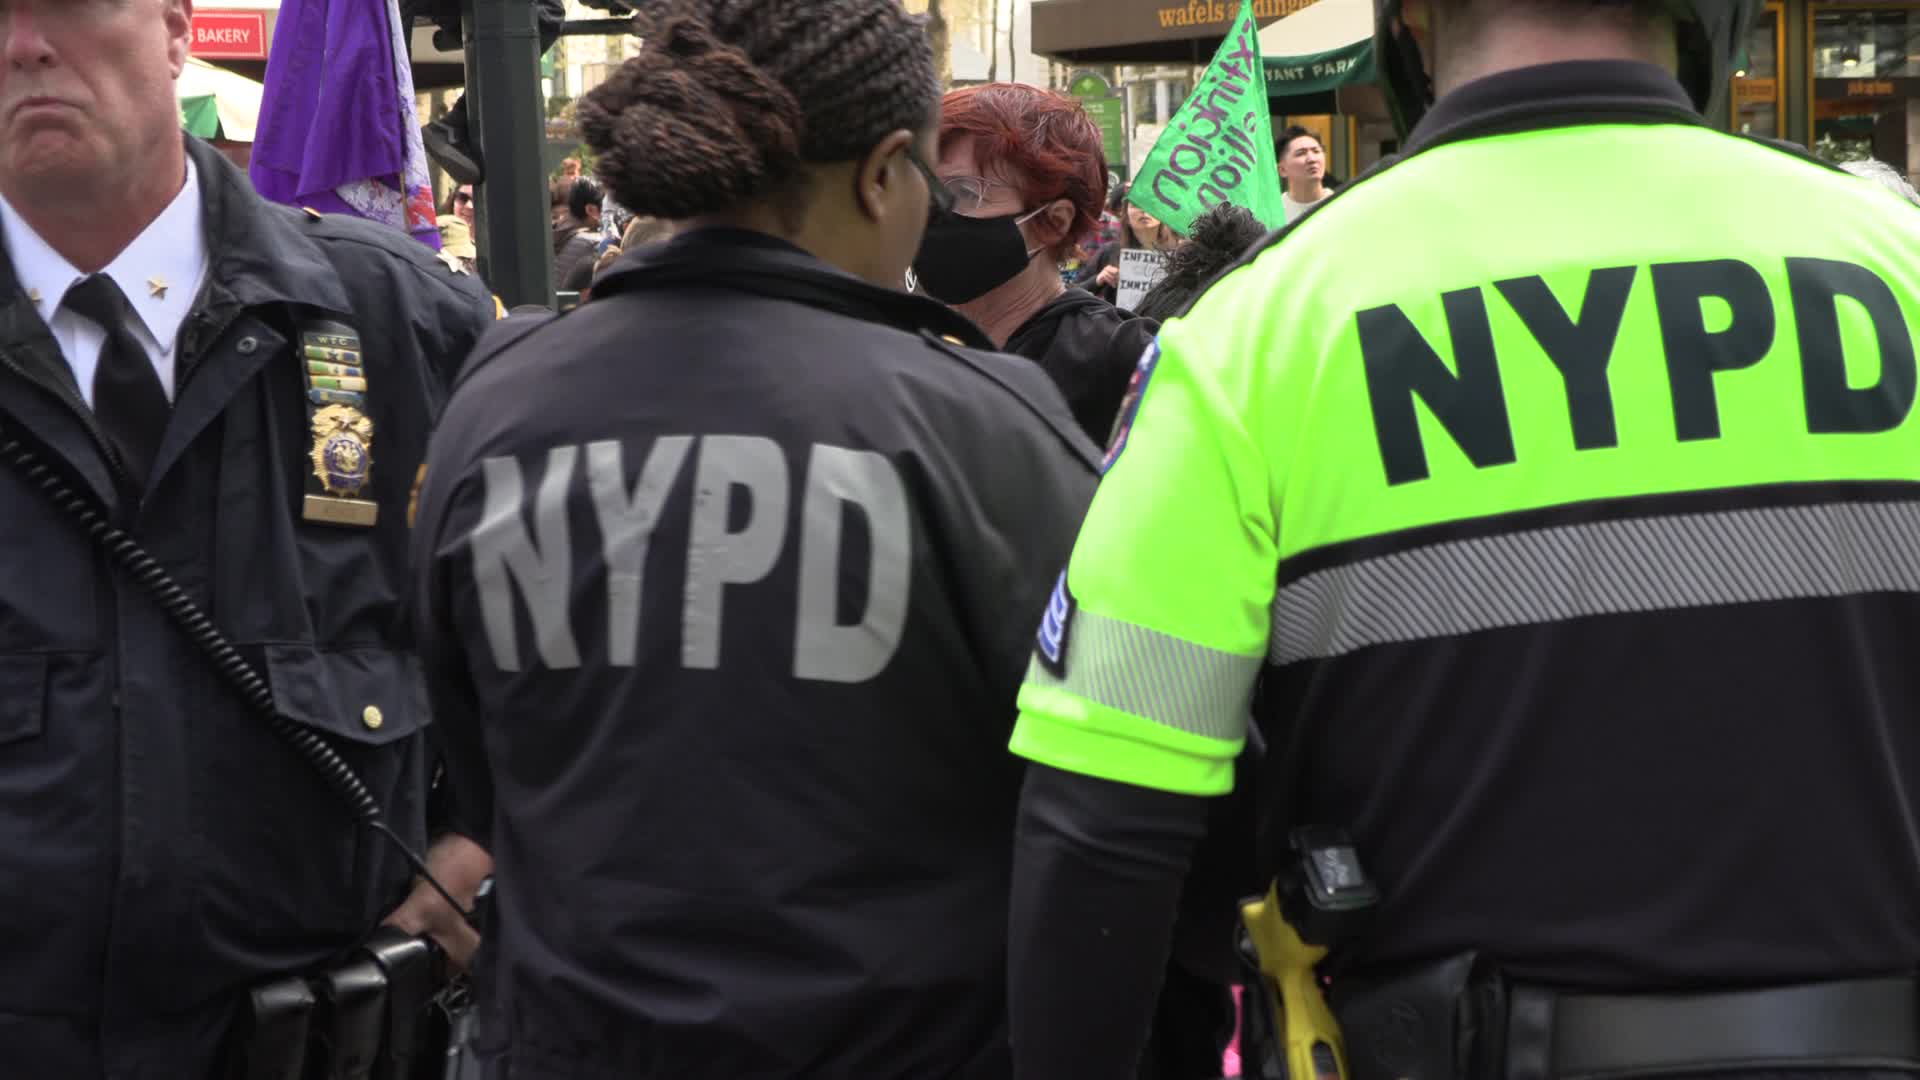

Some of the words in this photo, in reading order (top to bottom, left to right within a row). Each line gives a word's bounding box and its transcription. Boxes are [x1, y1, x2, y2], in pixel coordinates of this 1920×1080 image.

[1159, 0, 1224, 27] wafels
[197, 27, 249, 43] BAKERY
[1312, 57, 1357, 77] PARK
[1356, 257, 1918, 487] NYPD
[471, 434, 911, 683] NYPD
